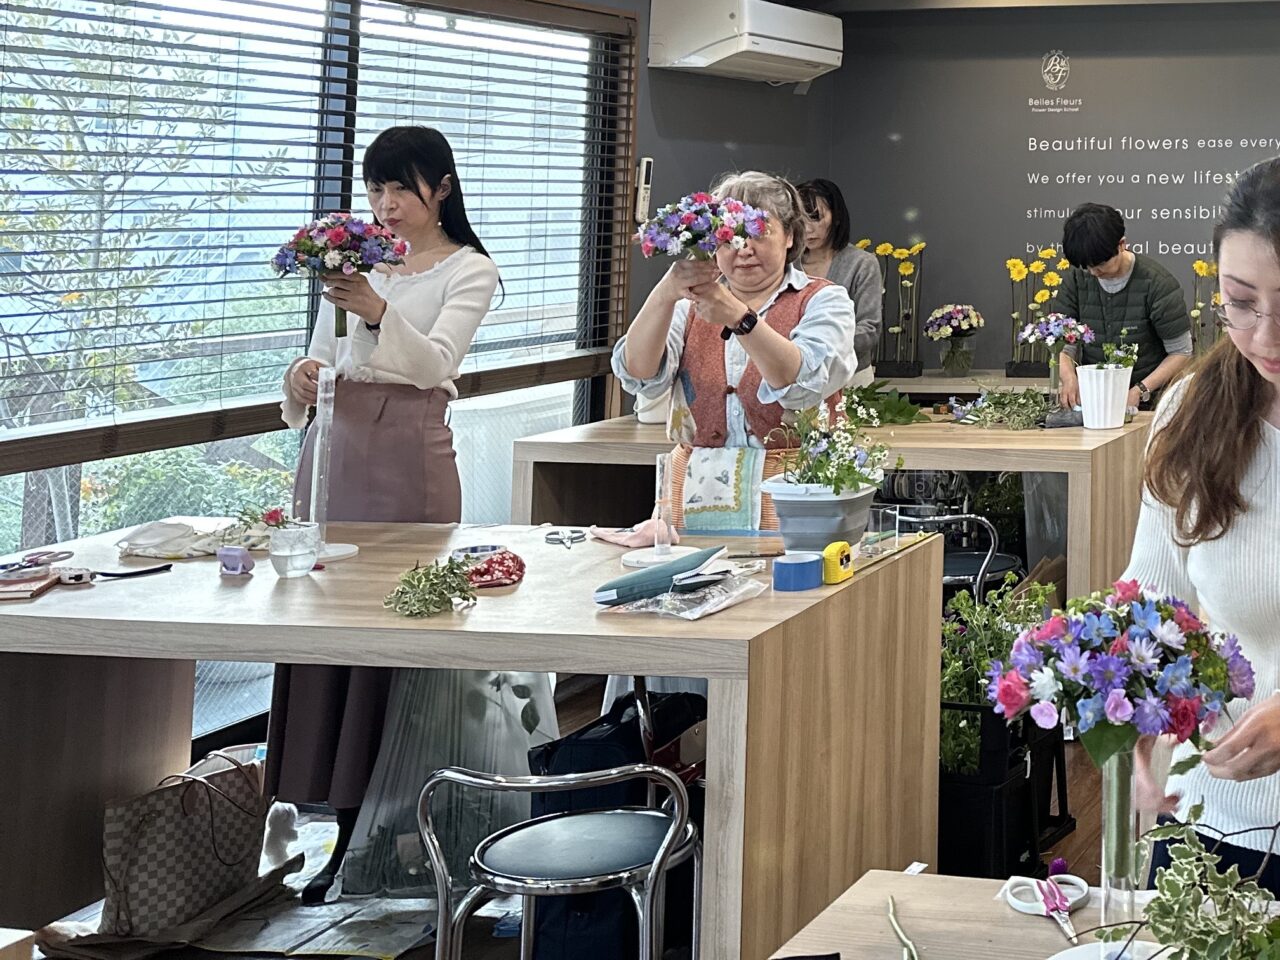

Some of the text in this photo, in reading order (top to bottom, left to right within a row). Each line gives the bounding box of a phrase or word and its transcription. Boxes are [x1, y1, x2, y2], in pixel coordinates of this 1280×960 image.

[1028, 97, 1082, 106] Belles Fleurs
[1028, 136, 1112, 151] Beautiful
[1121, 136, 1189, 150] flowers
[1197, 138, 1233, 148] ease
[1027, 170, 1240, 186] We offer you a new lifest
[1026, 207, 1074, 219] stimul
[1151, 205, 1221, 220] sensibil
[1050, 242, 1064, 253] th
[1159, 241, 1213, 254] beaut
